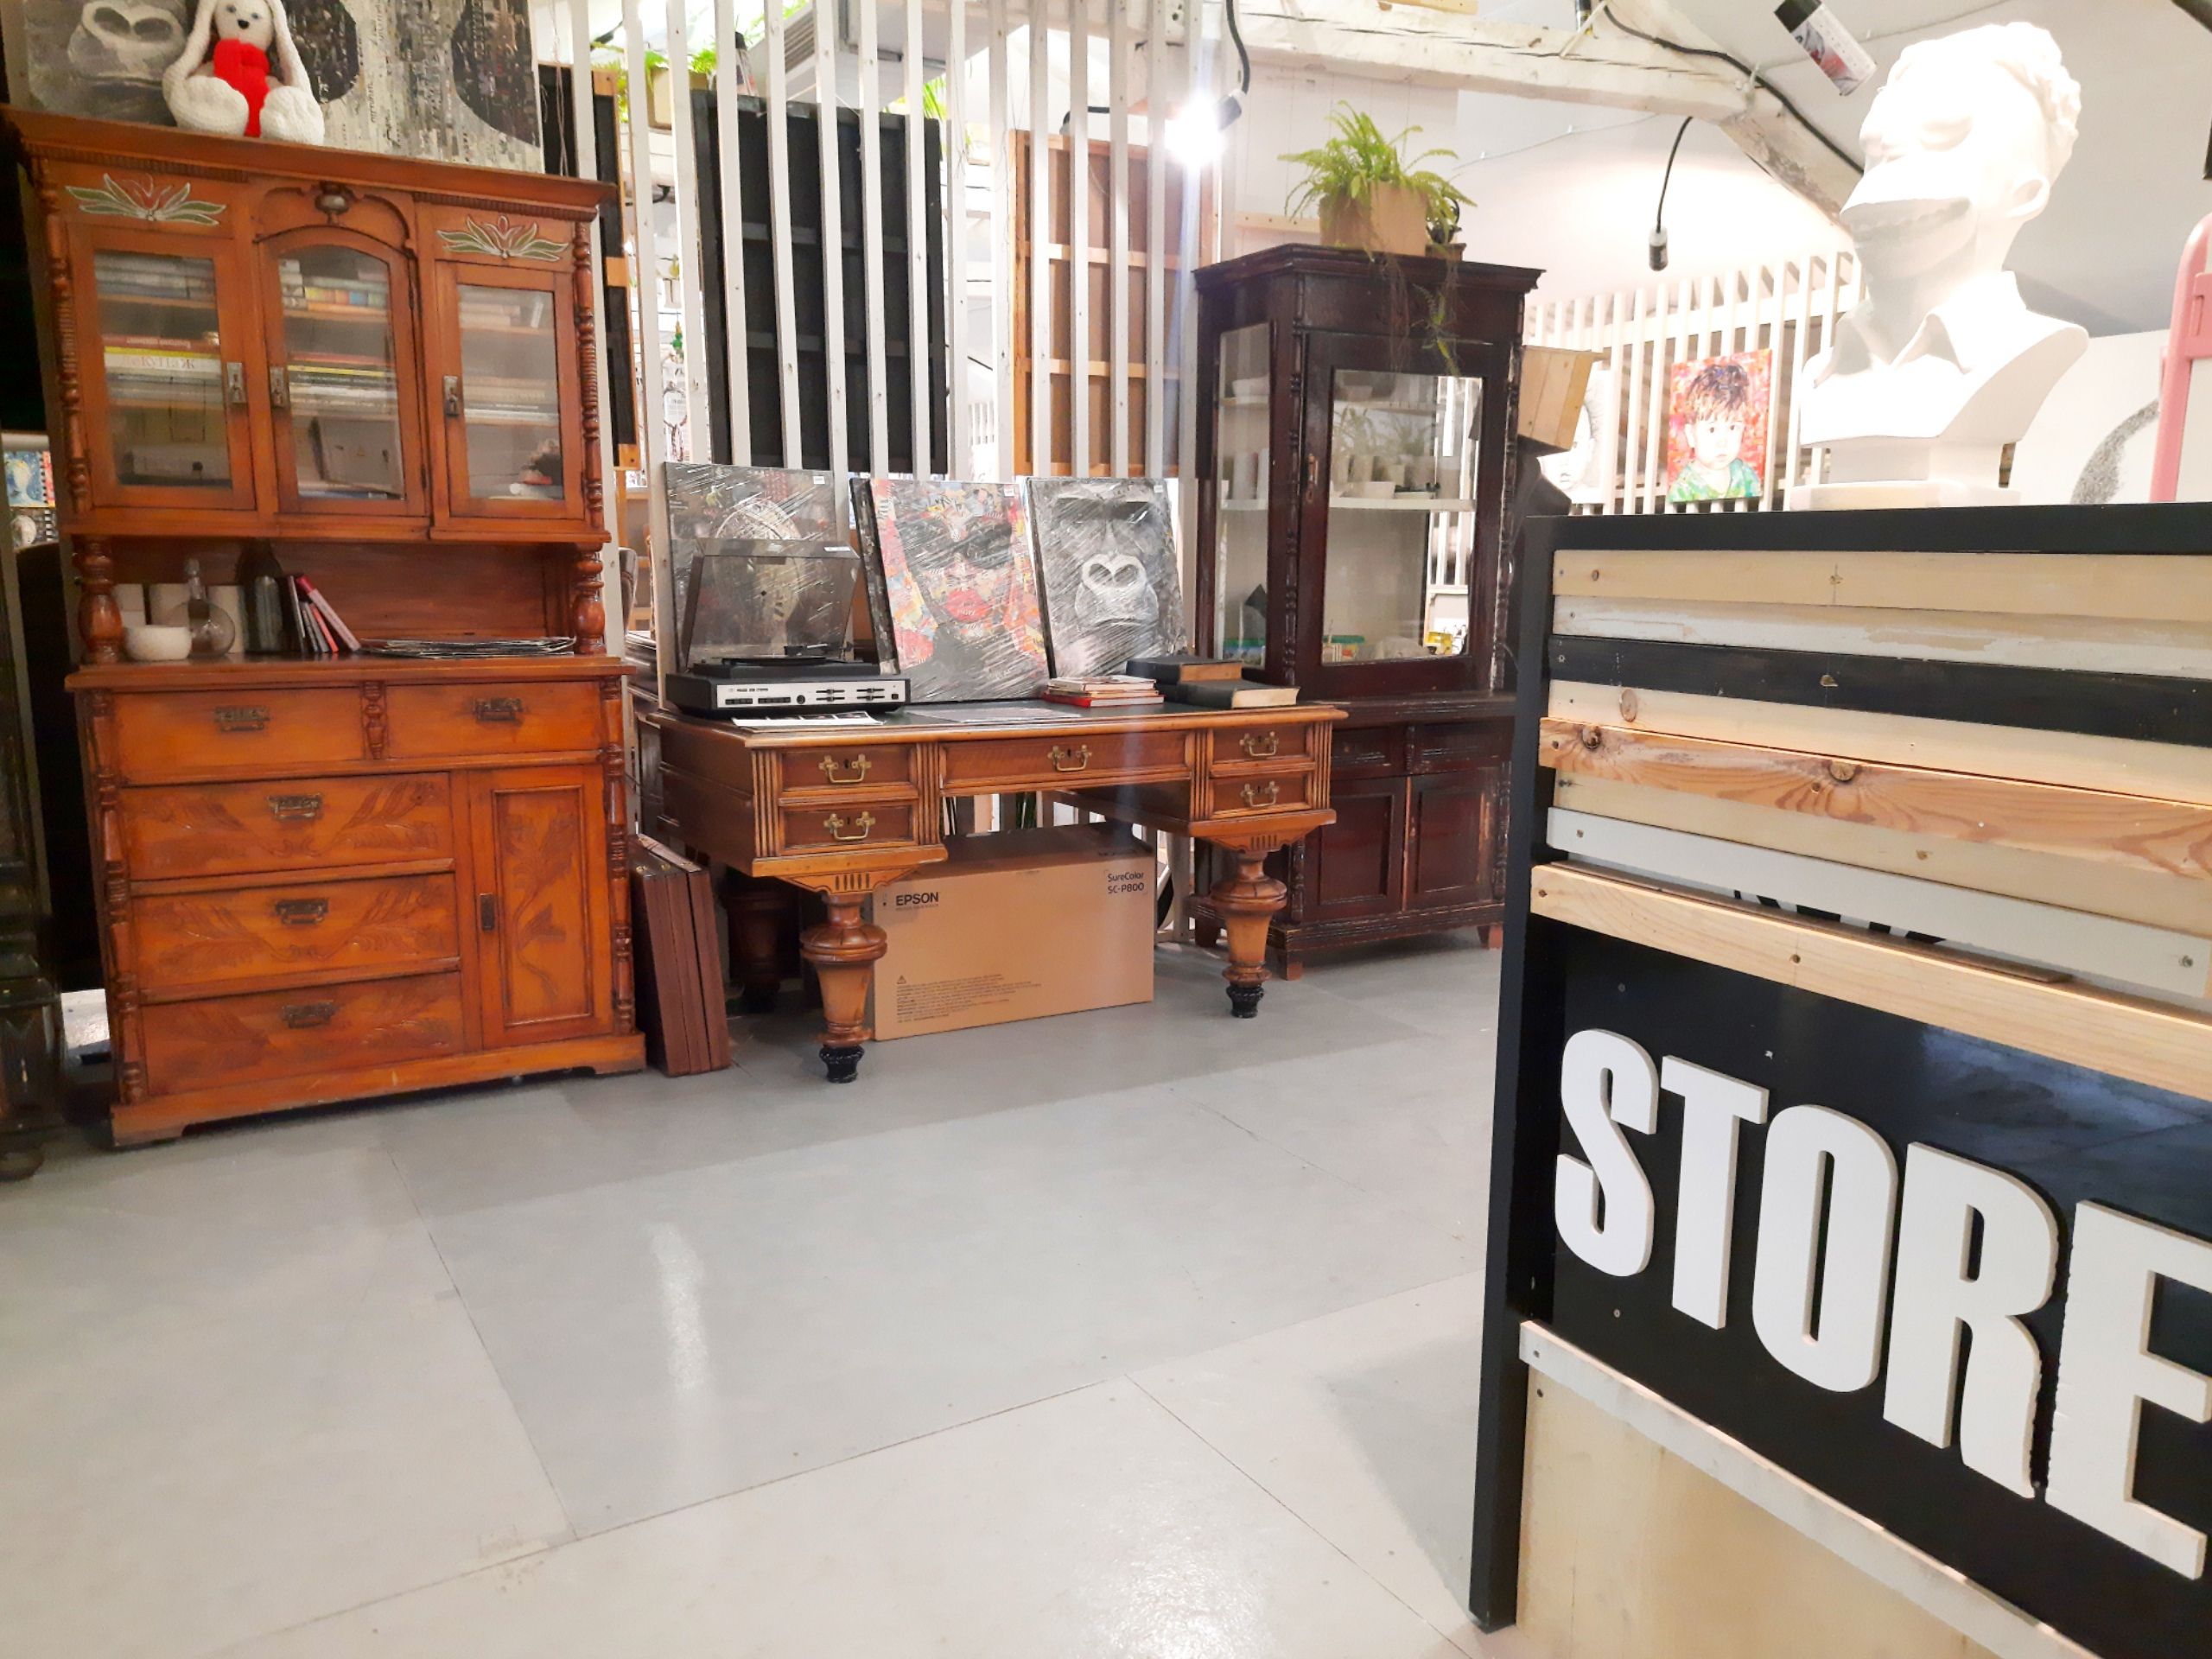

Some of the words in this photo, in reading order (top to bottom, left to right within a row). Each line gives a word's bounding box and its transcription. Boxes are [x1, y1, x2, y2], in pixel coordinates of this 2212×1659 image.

[1107, 872, 1144, 882] SureColor
[1107, 882, 1145, 894] SC-P800
[895, 891, 939, 906] EPSON
[1554, 1027, 2212, 1581] STORE
